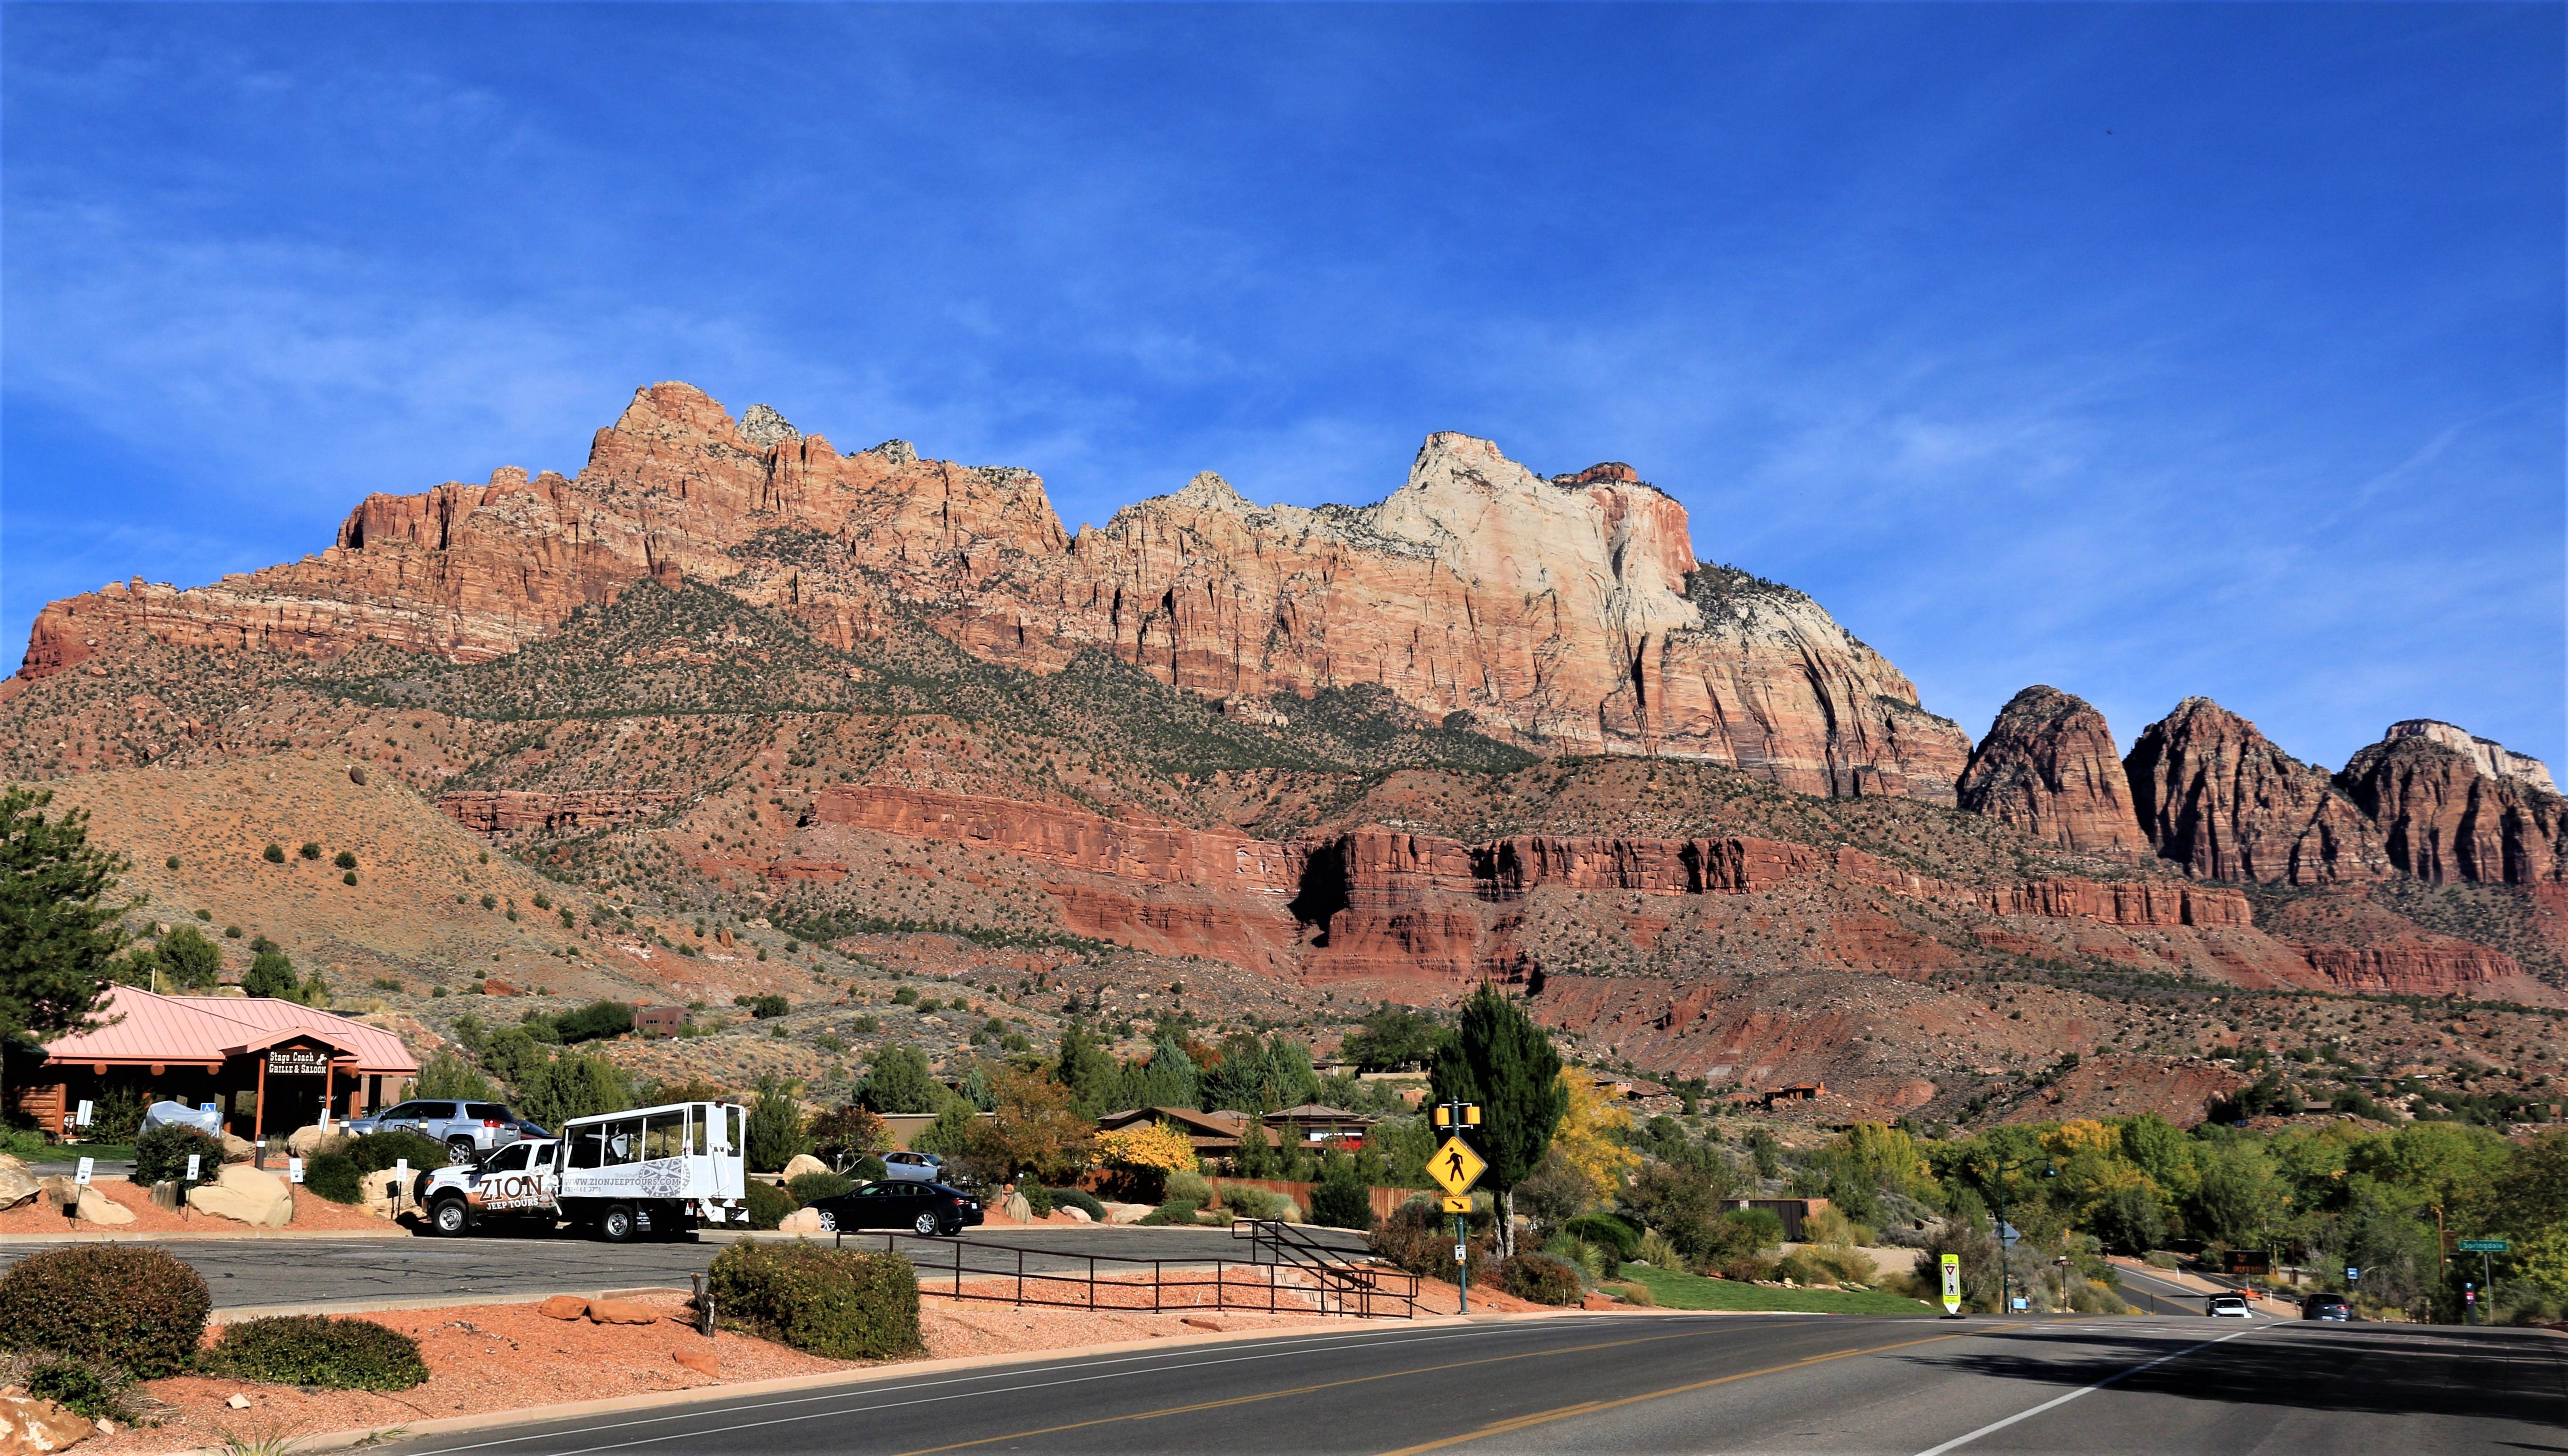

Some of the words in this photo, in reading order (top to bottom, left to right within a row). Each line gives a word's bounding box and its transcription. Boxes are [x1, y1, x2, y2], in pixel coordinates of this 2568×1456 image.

[270, 1051, 290, 1064] Stage
[293, 1052, 314, 1062] Coach
[269, 1064, 293, 1073] GRILLE
[294, 1065, 300, 1074] &
[301, 1064, 327, 1074] SALOON
[479, 1174, 544, 1201] ZION
[487, 1201, 507, 1210] JEEP
[508, 1198, 538, 1208] TOURS
